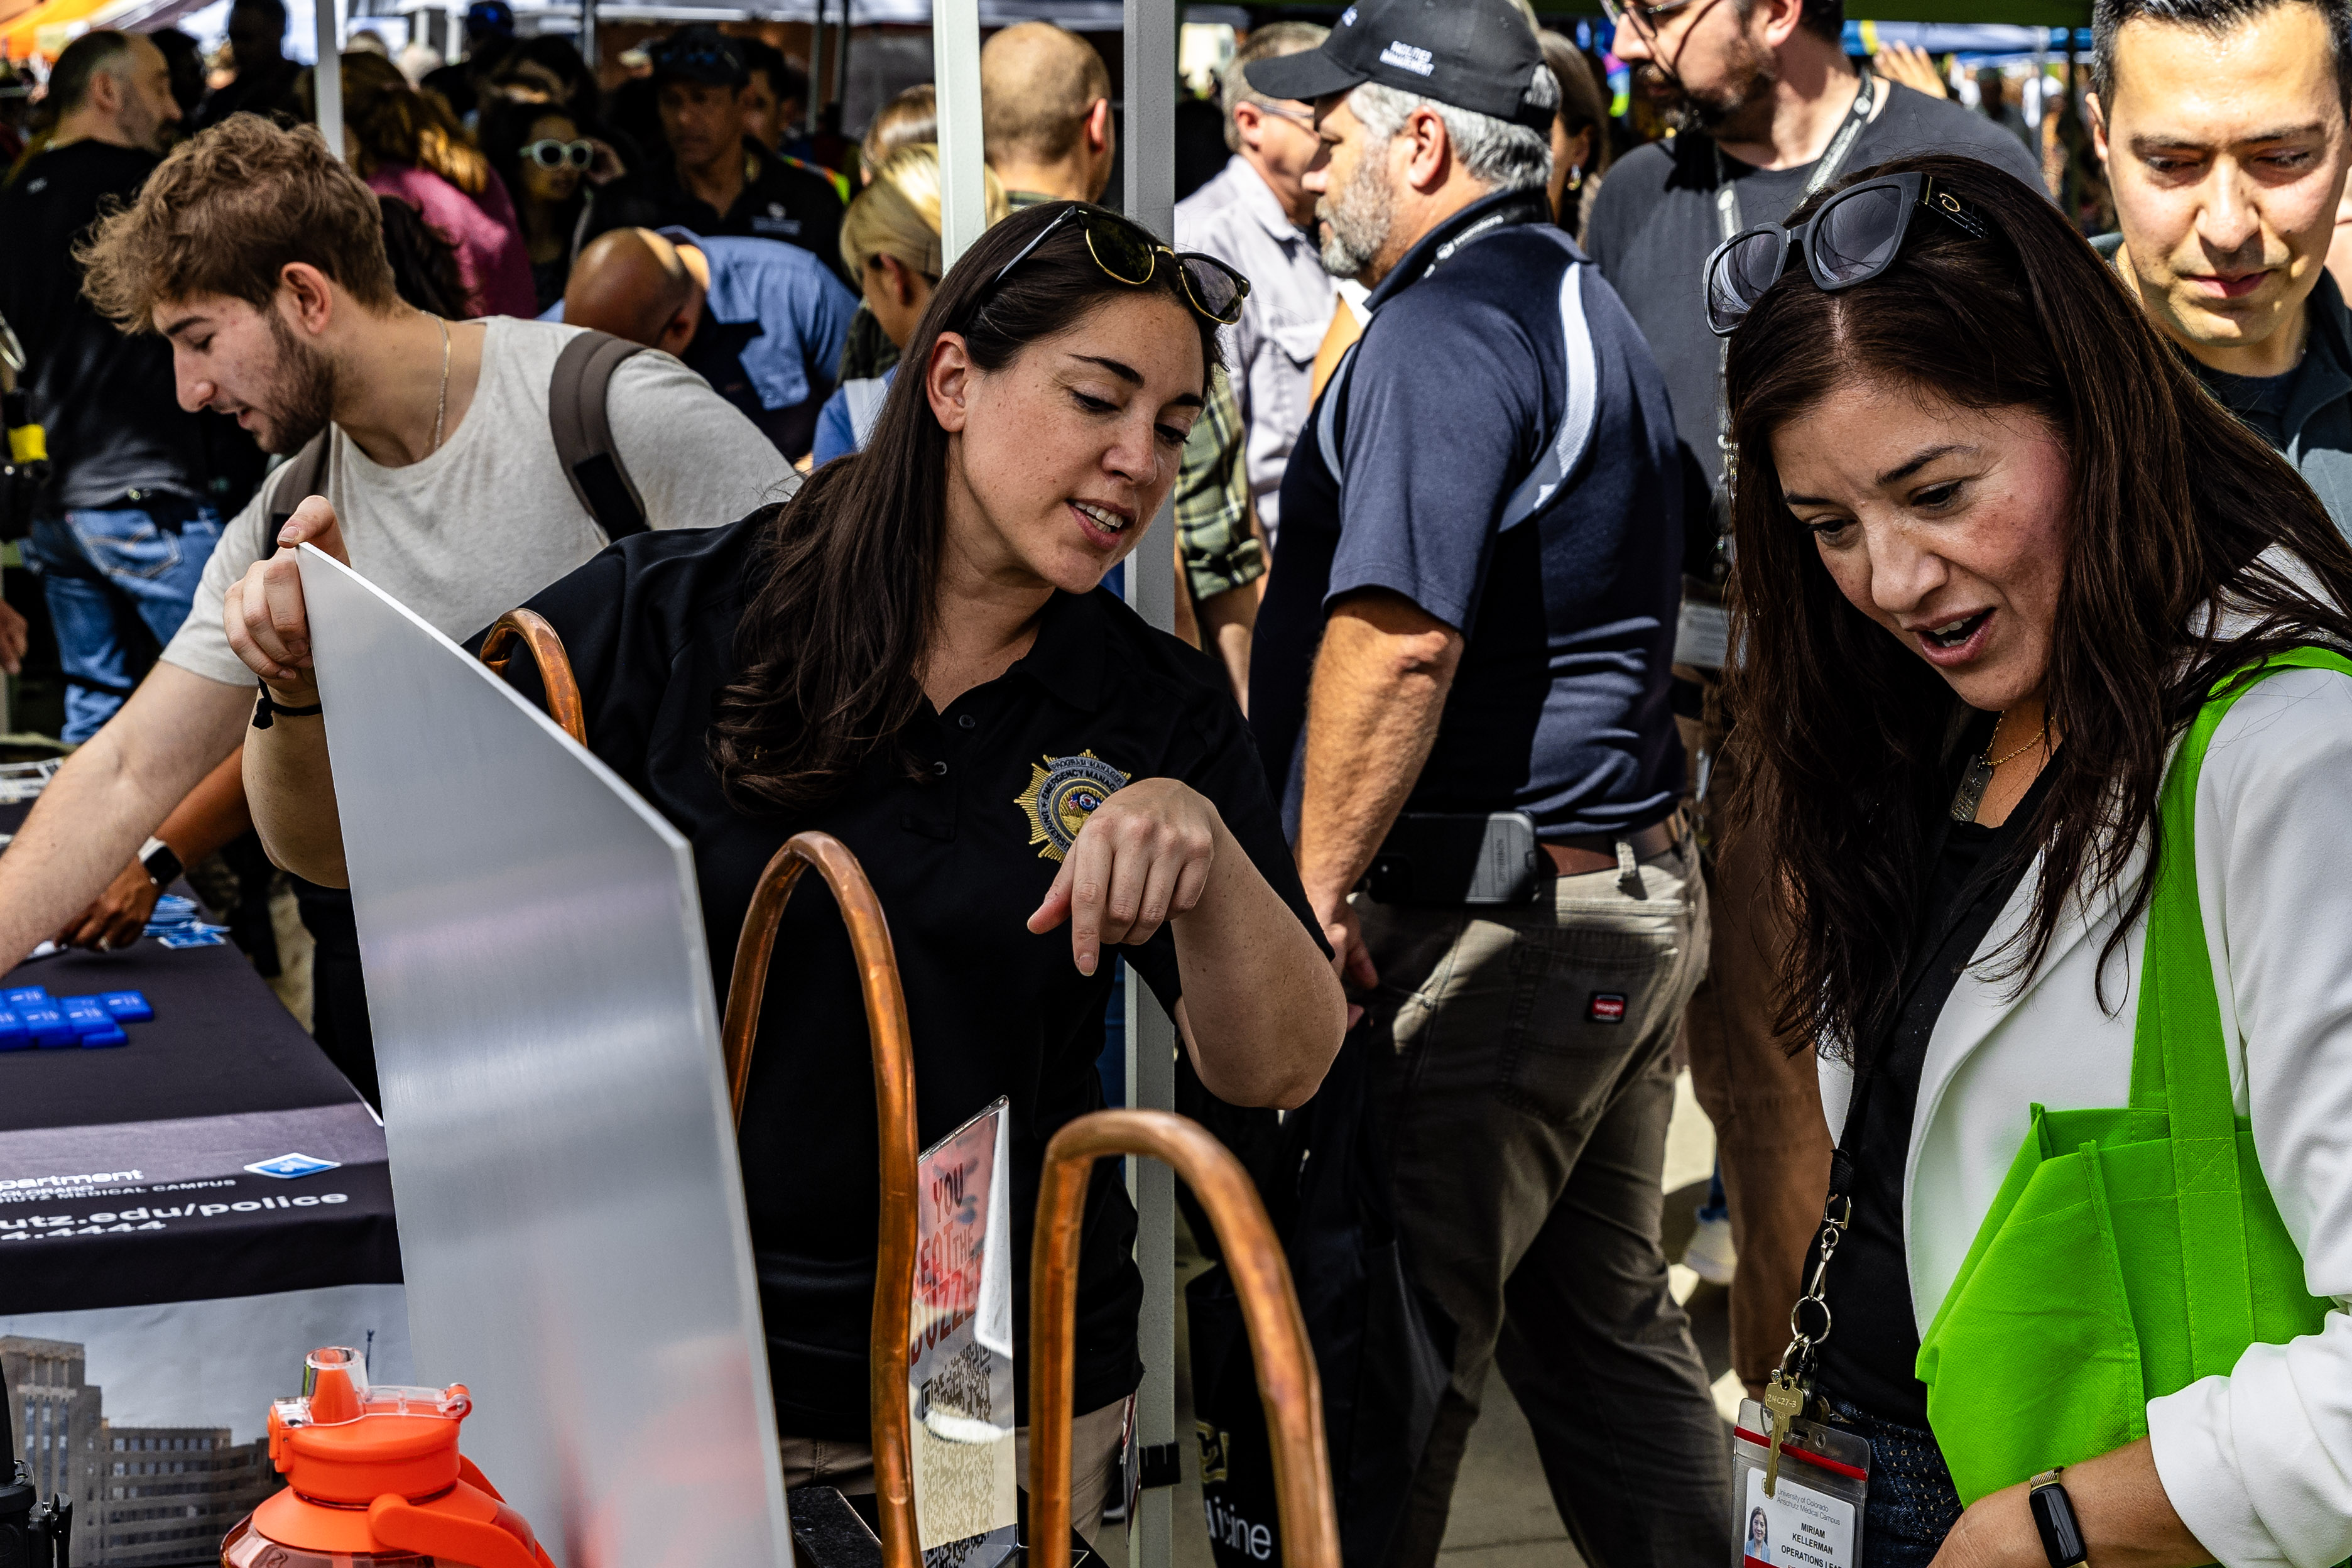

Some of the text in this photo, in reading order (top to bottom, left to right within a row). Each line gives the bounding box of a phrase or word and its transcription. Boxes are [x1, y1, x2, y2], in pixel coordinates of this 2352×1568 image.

[1042, 768, 1118, 800] EMERGENCY MANAG
[1051, 758, 1124, 785] PROGRAM MANAGER
[152, 1179, 236, 1192] CAMPUS
[932, 1163, 964, 1224] YOU
[913, 1220, 974, 1299] EAT THE
[1777, 1488, 1801, 1504] University
[1806, 1498, 1829, 1513] Colorado
[1777, 1496, 1841, 1526] Anschutz Medical Campus
[1792, 1532, 1833, 1555] KELLERMAN
[1800, 1522, 1826, 1539] MIRIAM
[1781, 1544, 1824, 1568] OPERATIONS
